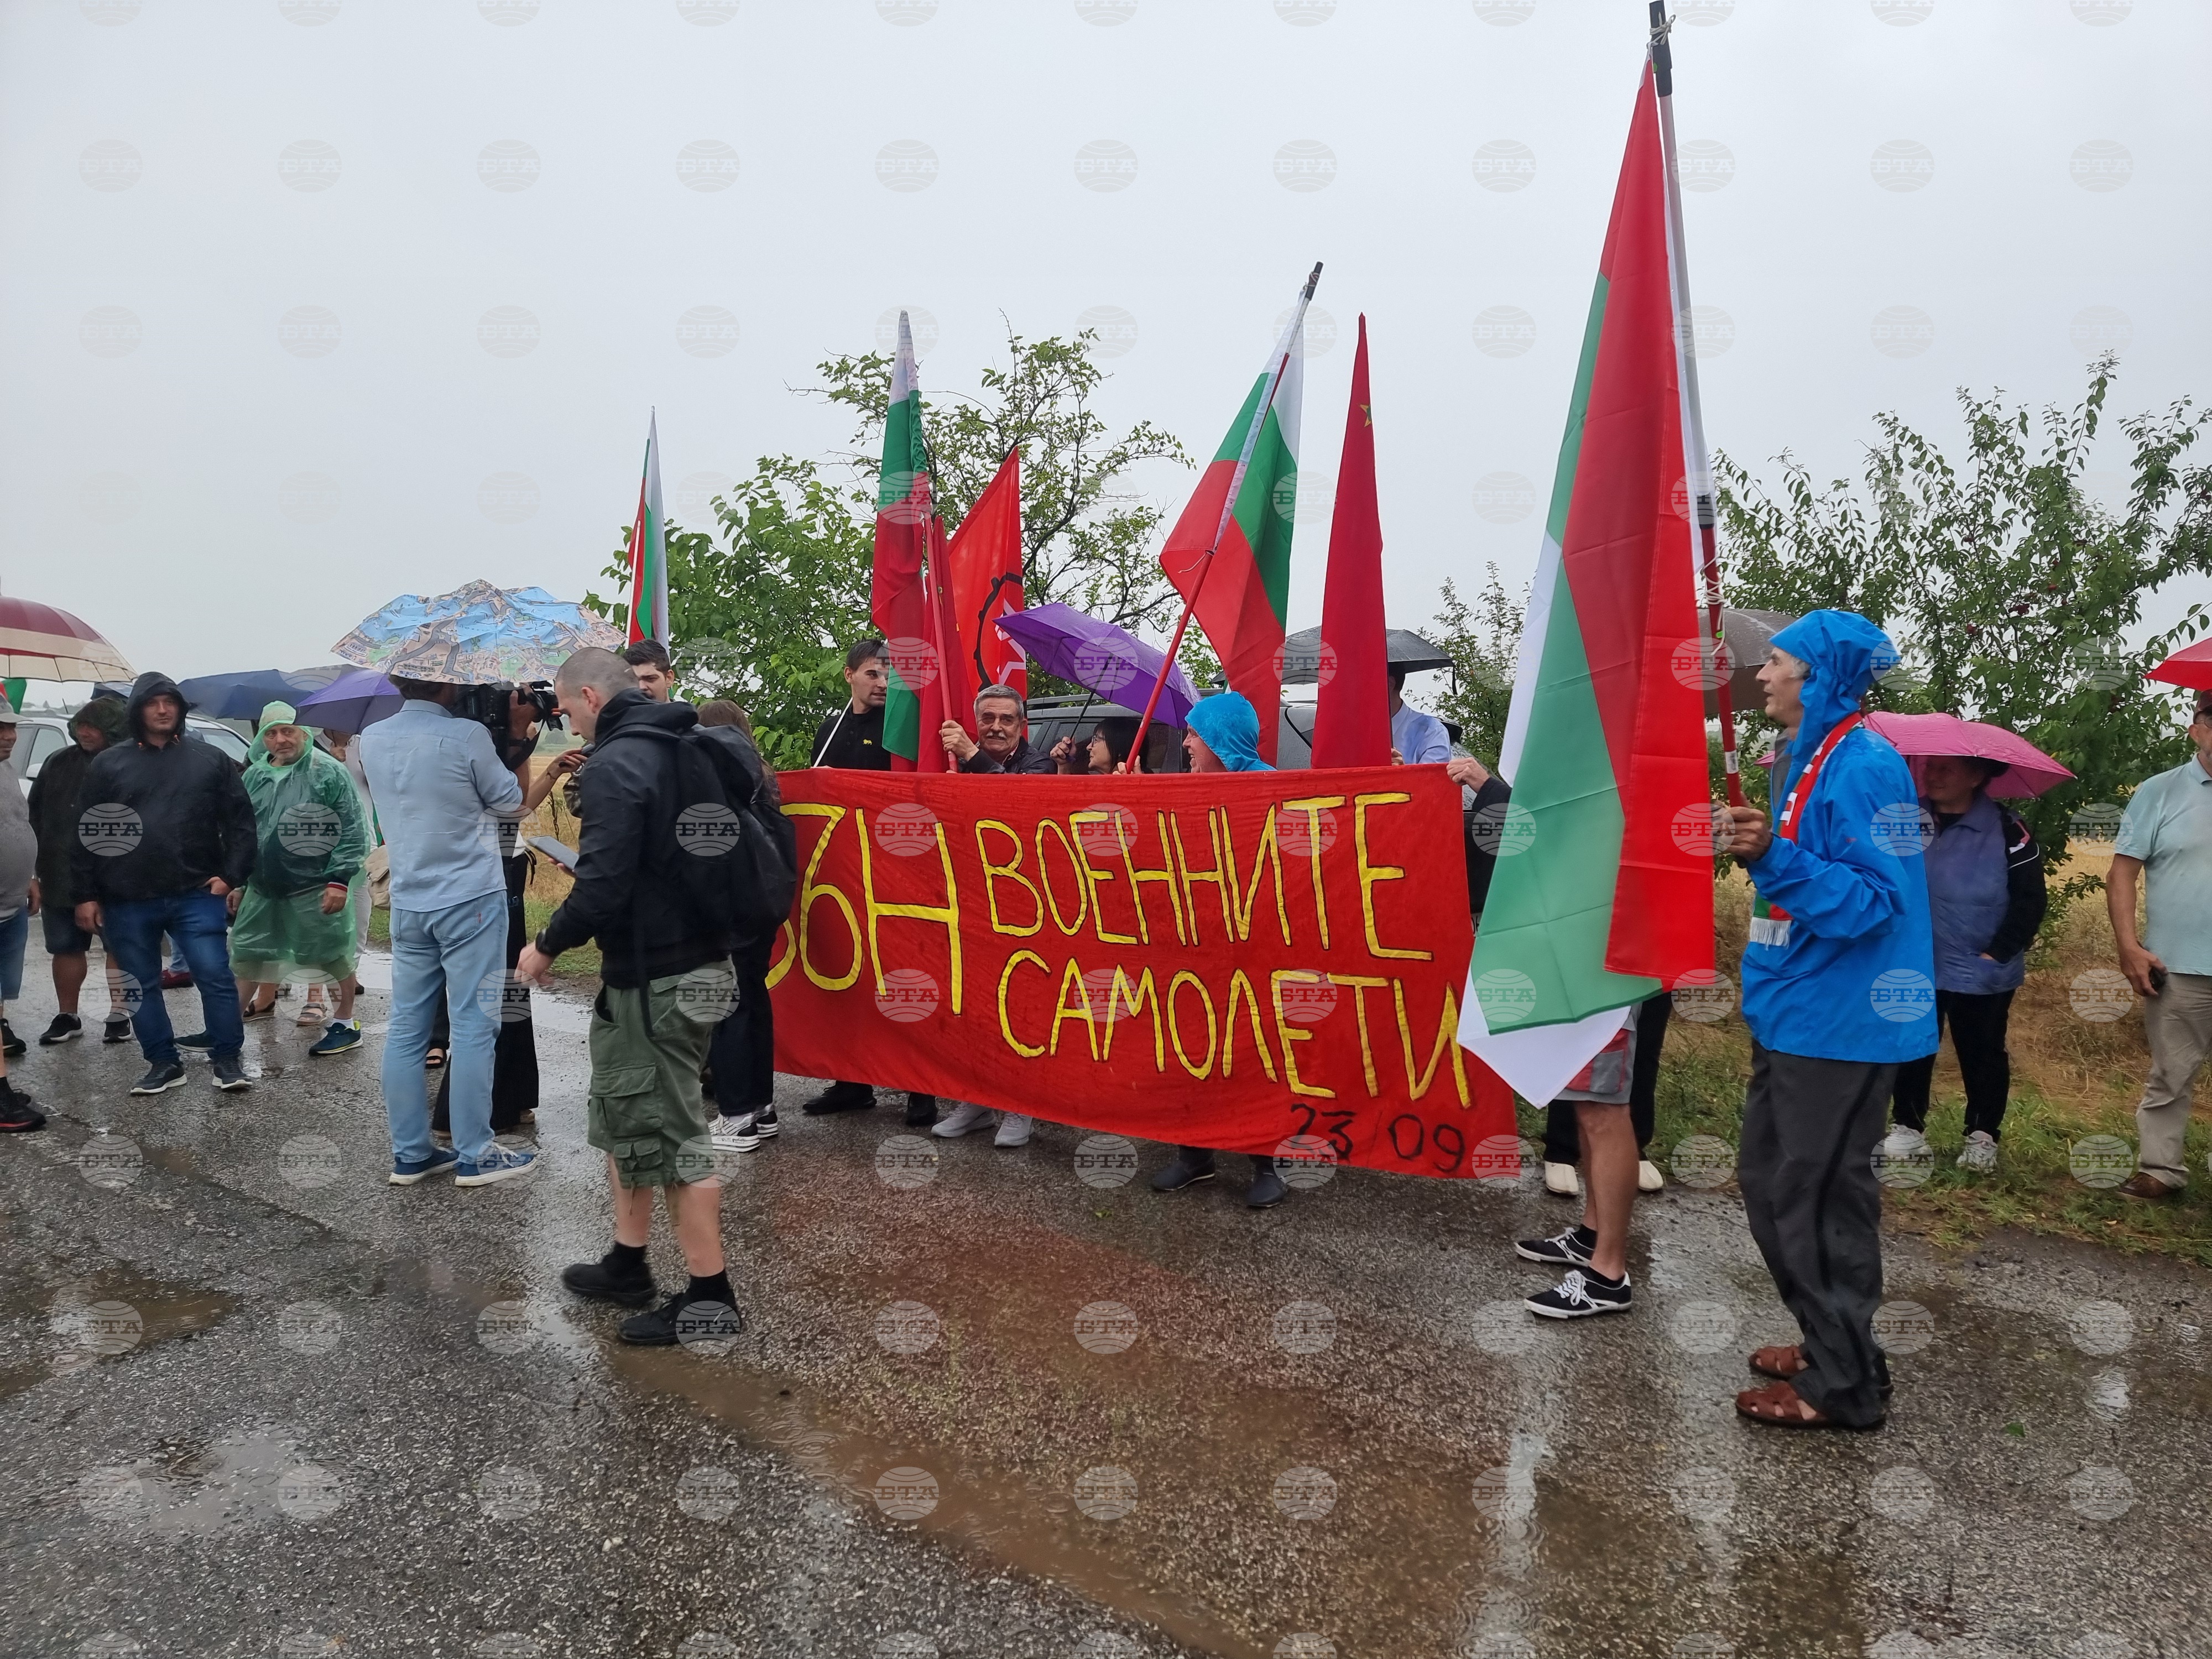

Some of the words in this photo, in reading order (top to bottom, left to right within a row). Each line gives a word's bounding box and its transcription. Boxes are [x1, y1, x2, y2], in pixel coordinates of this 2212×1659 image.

[765, 802, 963, 1016] ЪН
[975, 792, 1433, 961] ВОЕННИТЕ
[997, 949, 1471, 1109] САМОЛЕТИ
